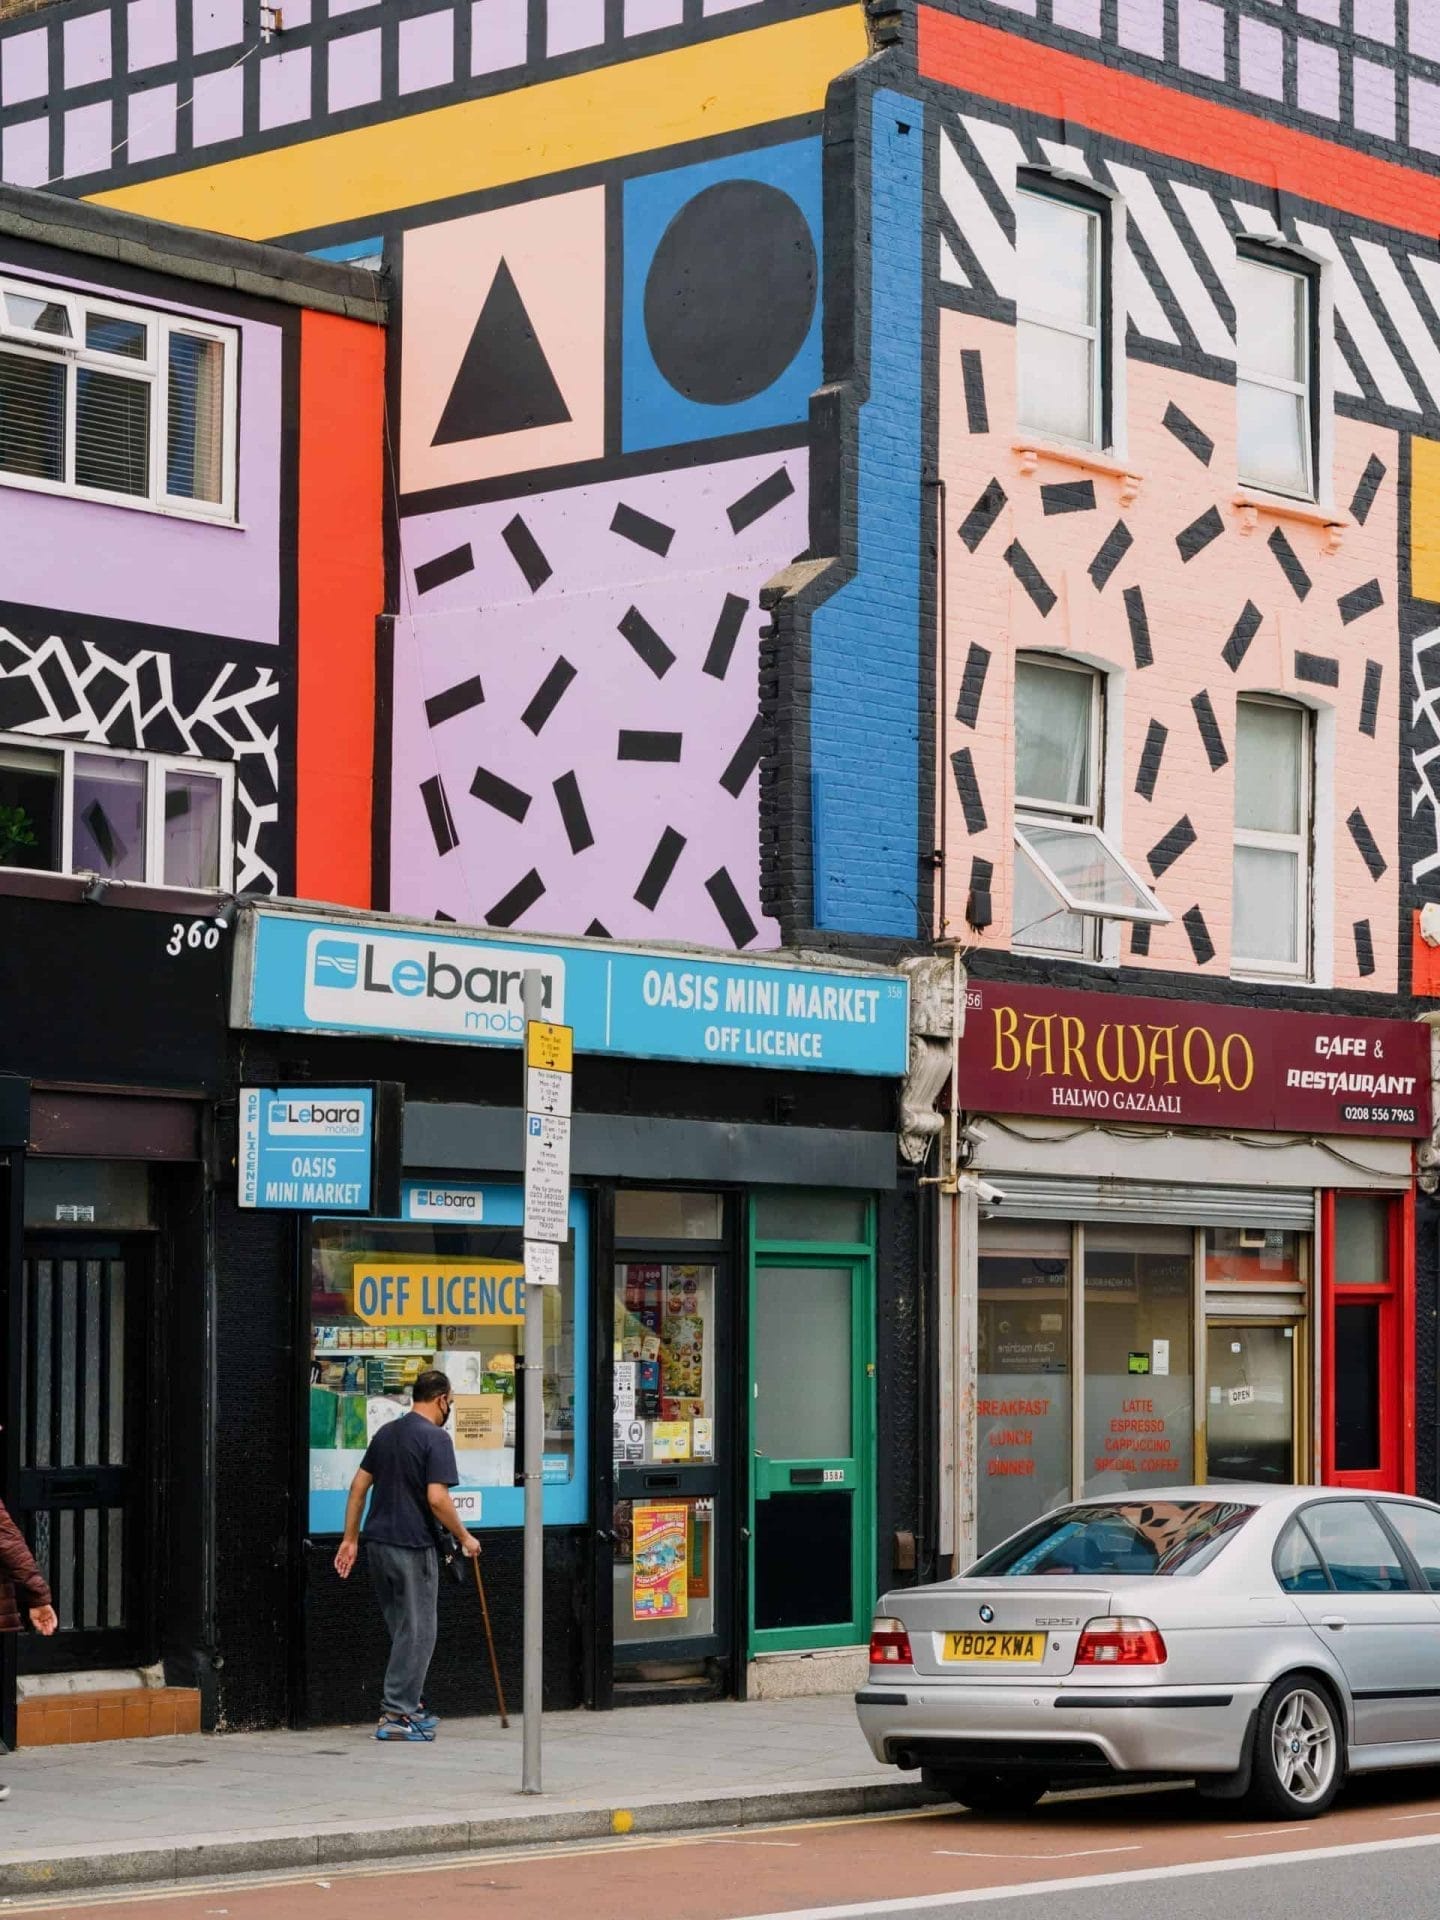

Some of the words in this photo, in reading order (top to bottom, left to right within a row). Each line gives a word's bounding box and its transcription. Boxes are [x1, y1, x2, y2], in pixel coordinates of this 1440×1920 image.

[166, 920, 219, 956] 360
[642, 970, 719, 1012] OASIS
[725, 977, 780, 1016] MINI
[786, 983, 880, 1024] MARKET
[704, 1025, 741, 1054] OFF
[745, 1028, 823, 1059] LICENCE
[990, 1006, 1254, 1092] BARWAQO
[1373, 1039, 1384, 1059] &
[247, 1095, 257, 1122] OFF
[1051, 1087, 1109, 1109] HALWO
[1112, 1091, 1182, 1114] GAZAALI
[288, 1104, 360, 1123] Lebara
[1344, 1106, 1369, 1120] 0208
[1371, 1107, 1389, 1121] 556
[1391, 1109, 1415, 1122] 7963
[325, 1124, 360, 1135] mobile
[245, 1131, 256, 1202] LICENCE
[291, 1157, 337, 1178] OASIS
[265, 1182, 299, 1202] MINI
[301, 1183, 362, 1204] MARKET
[429, 1190, 475, 1208] Lebara
[359, 1276, 410, 1316] OFF
[422, 1276, 527, 1316] LICENCE
[1232, 1390, 1250, 1401] OPEN
[1122, 1399, 1153, 1413] LATTE
[1110, 1418, 1165, 1433] ESPRESSO
[989, 1429, 1033, 1447] LUNCH
[1104, 1438, 1171, 1453] CAPPUCCINO
[987, 1459, 1034, 1476] DINNER
[1094, 1457, 1137, 1472] SPECIAL
[1141, 1457, 1180, 1472] COFFEE
[1035, 1617, 1080, 1627] 525i
[952, 1635, 996, 1656] YB02
[1000, 1636, 1034, 1656] KWA
